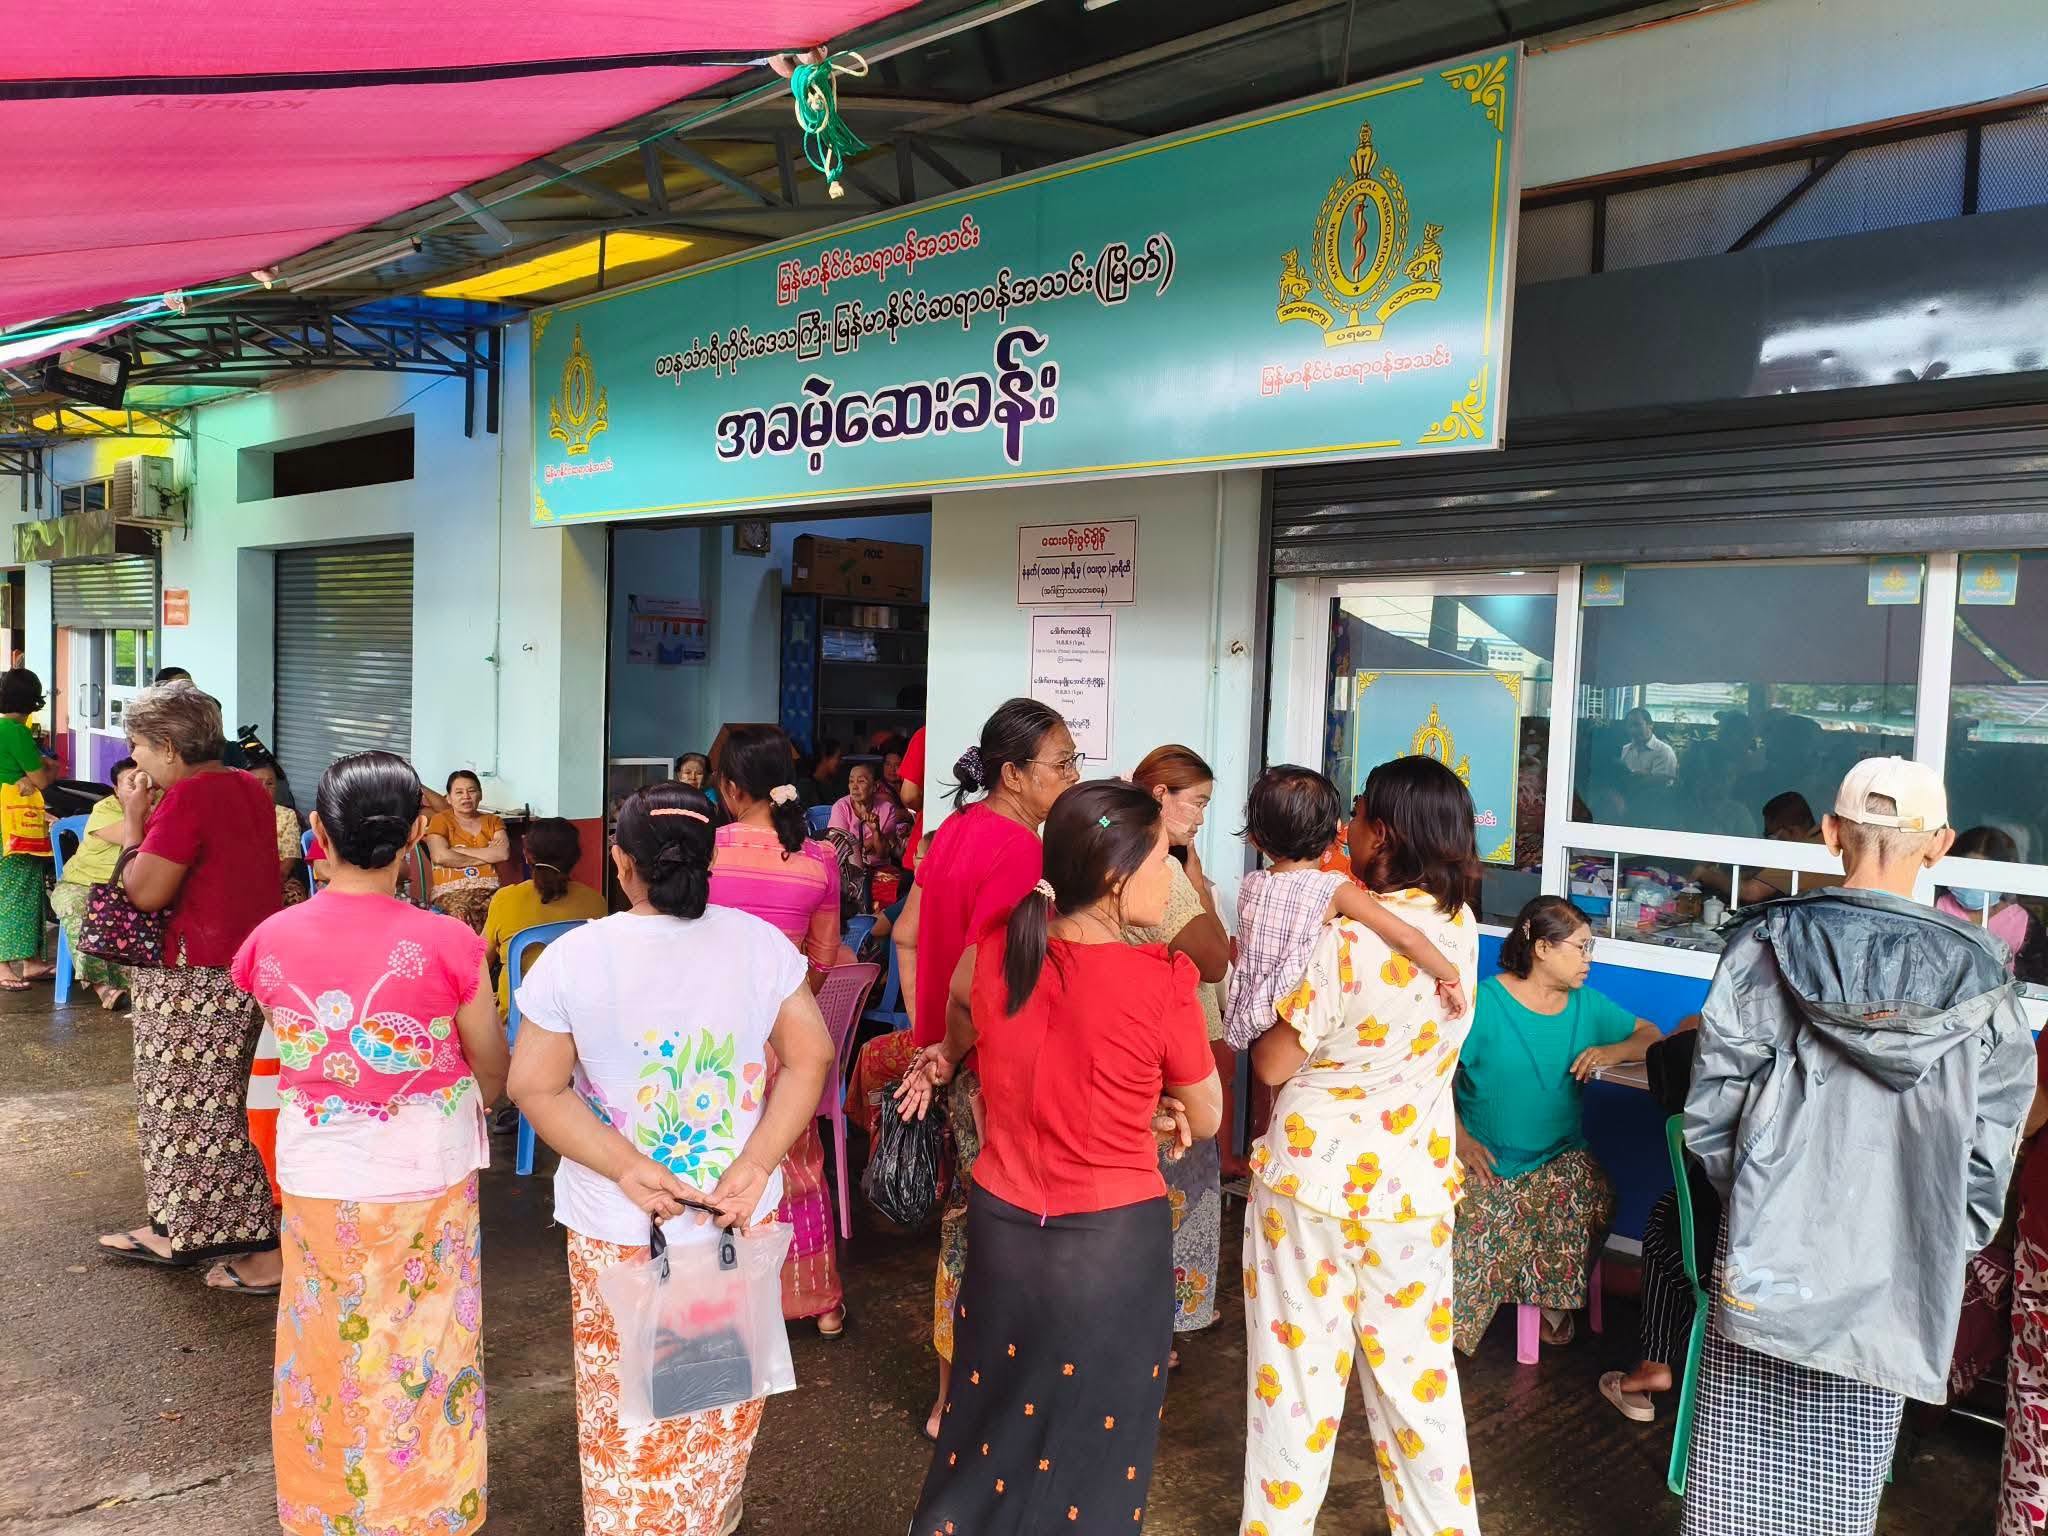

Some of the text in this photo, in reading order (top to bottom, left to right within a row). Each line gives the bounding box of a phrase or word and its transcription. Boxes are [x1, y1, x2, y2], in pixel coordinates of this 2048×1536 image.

[1327, 182, 1392, 280] MYANMAR MEDICAL ASSOCIATION
[778, 215, 980, 304] မြန်မာနိုင်ငံဆရာဝန်အသင်း
[1261, 344, 1451, 395] မြန်မာနိုင်ငံဆရာဝန်အသင်း
[717, 330, 1056, 471] အခမဲ့ဆေးခန်း
[1321, 1137, 1341, 1163] Duck
[1282, 1290, 1304, 1312] Duck
[1279, 1447, 1301, 1471] Duck
